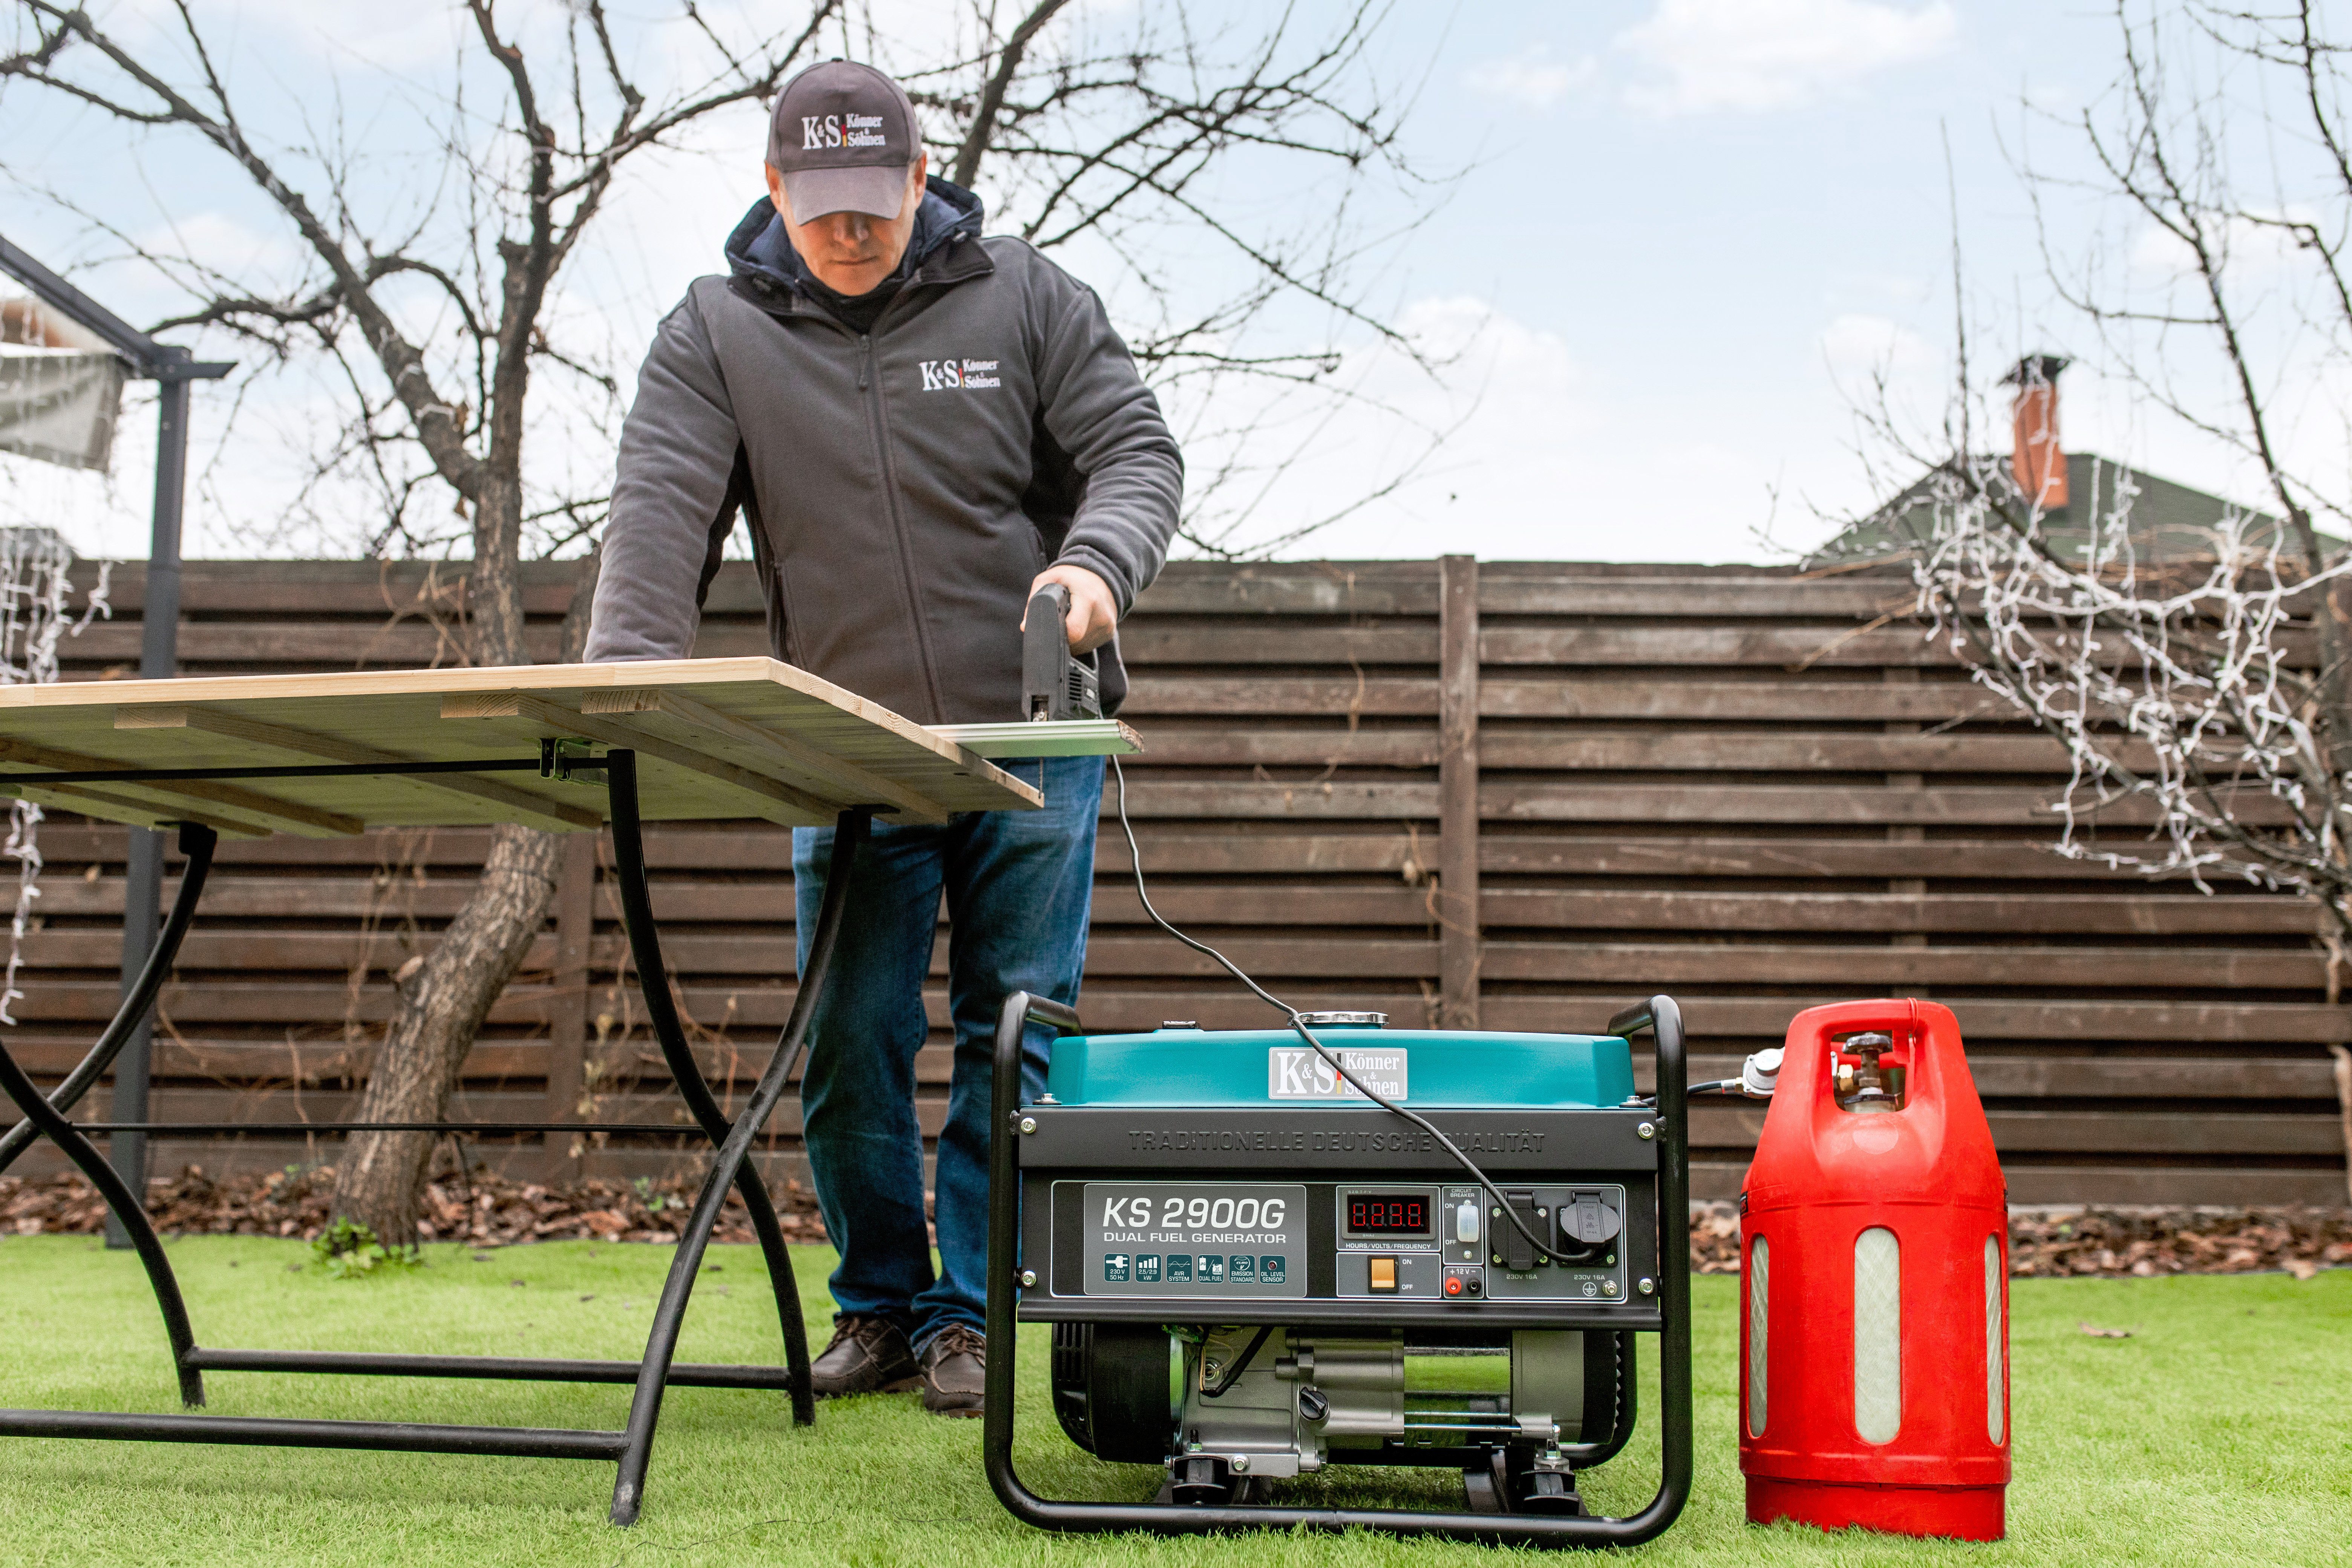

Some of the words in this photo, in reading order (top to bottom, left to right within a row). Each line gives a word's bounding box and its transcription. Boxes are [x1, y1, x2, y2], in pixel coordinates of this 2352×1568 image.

[801, 115, 841, 150] K&S
[919, 359, 960, 391] K&S
[1277, 1052, 1335, 1095] K&S
[1345, 1052, 1400, 1070] Könner
[1129, 1131, 1304, 1151] TRADITIONELLE
[1312, 1132, 1432, 1152] DEUTSCHE
[1102, 1197, 1152, 1228] KS
[1161, 1198, 1286, 1229] 2900G
[1104, 1232, 1146, 1242] DUAL
[1150, 1233, 1187, 1243] FUEL
[1191, 1233, 1286, 1243] GENERATOR
